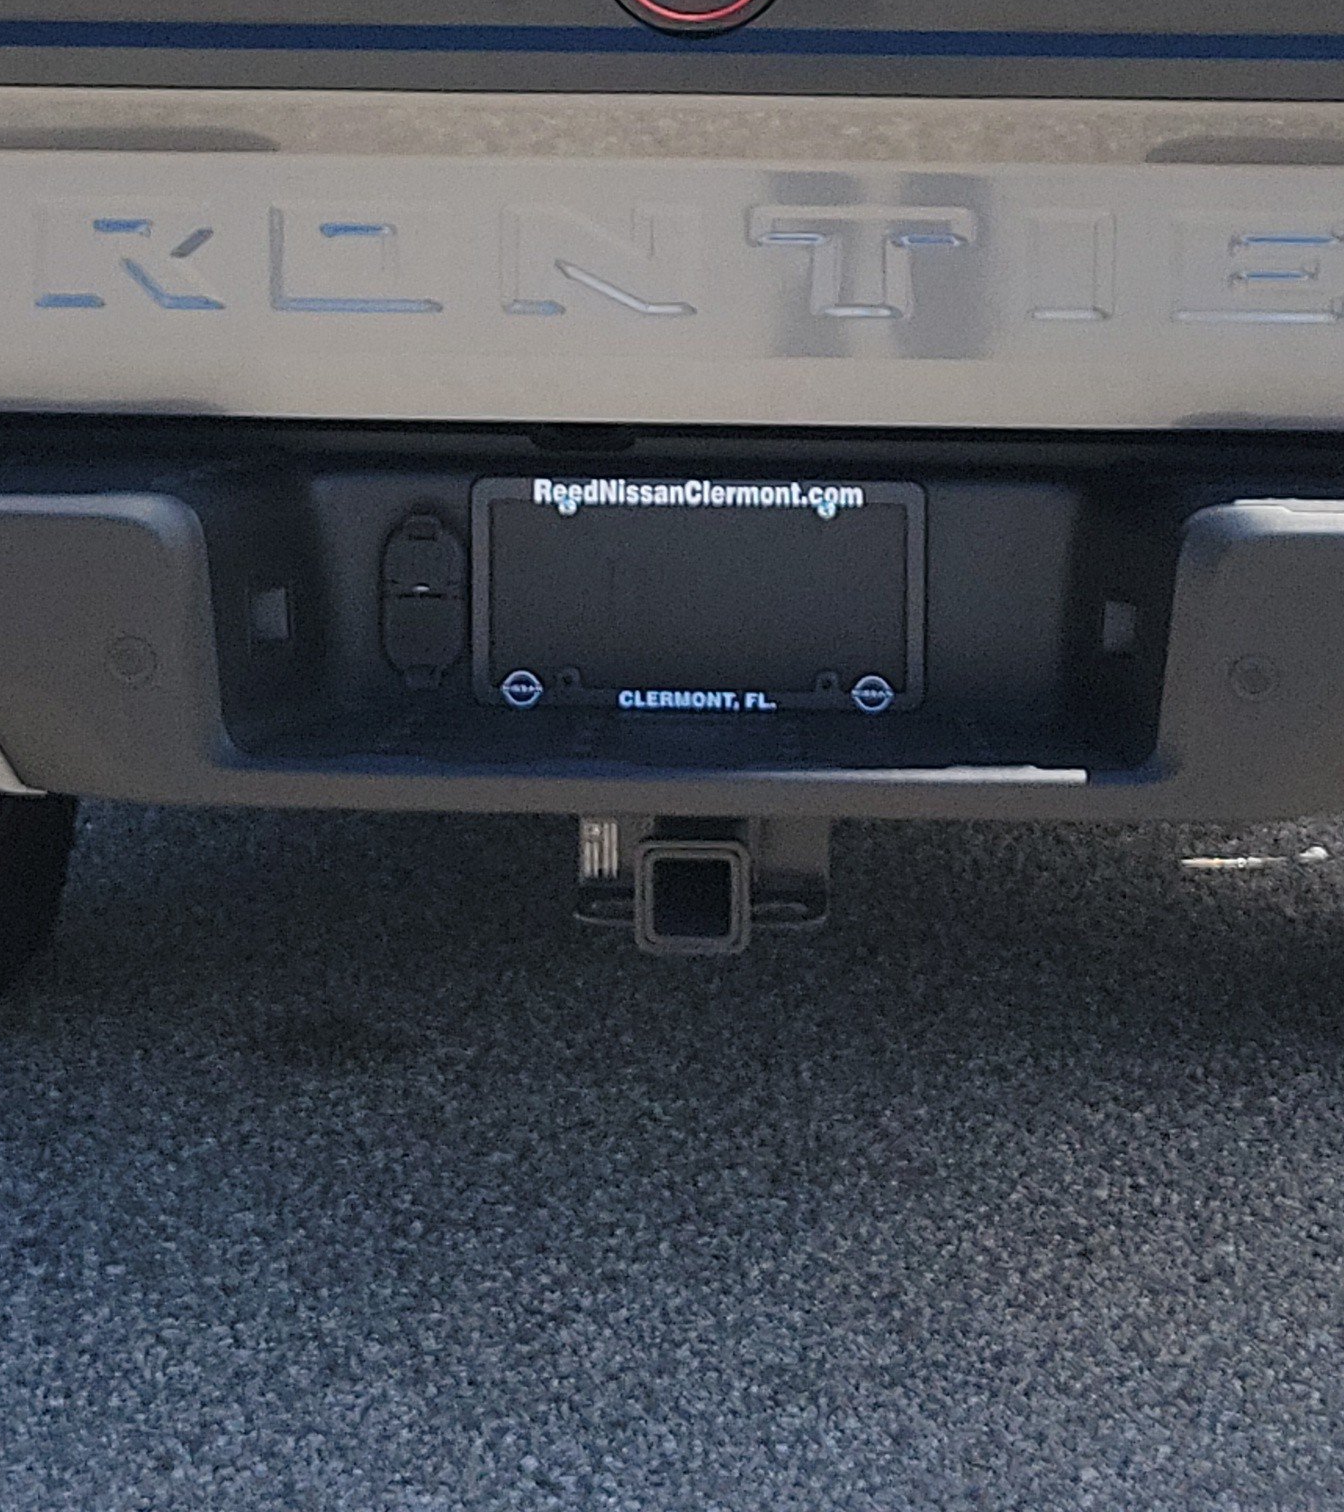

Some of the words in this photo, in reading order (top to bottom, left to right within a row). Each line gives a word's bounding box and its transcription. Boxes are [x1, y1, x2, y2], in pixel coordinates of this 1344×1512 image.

[533, 478, 864, 508] ReedNissanClermont.com
[617, 690, 740, 711] CLERMONT,
[744, 692, 778, 710] FL.
